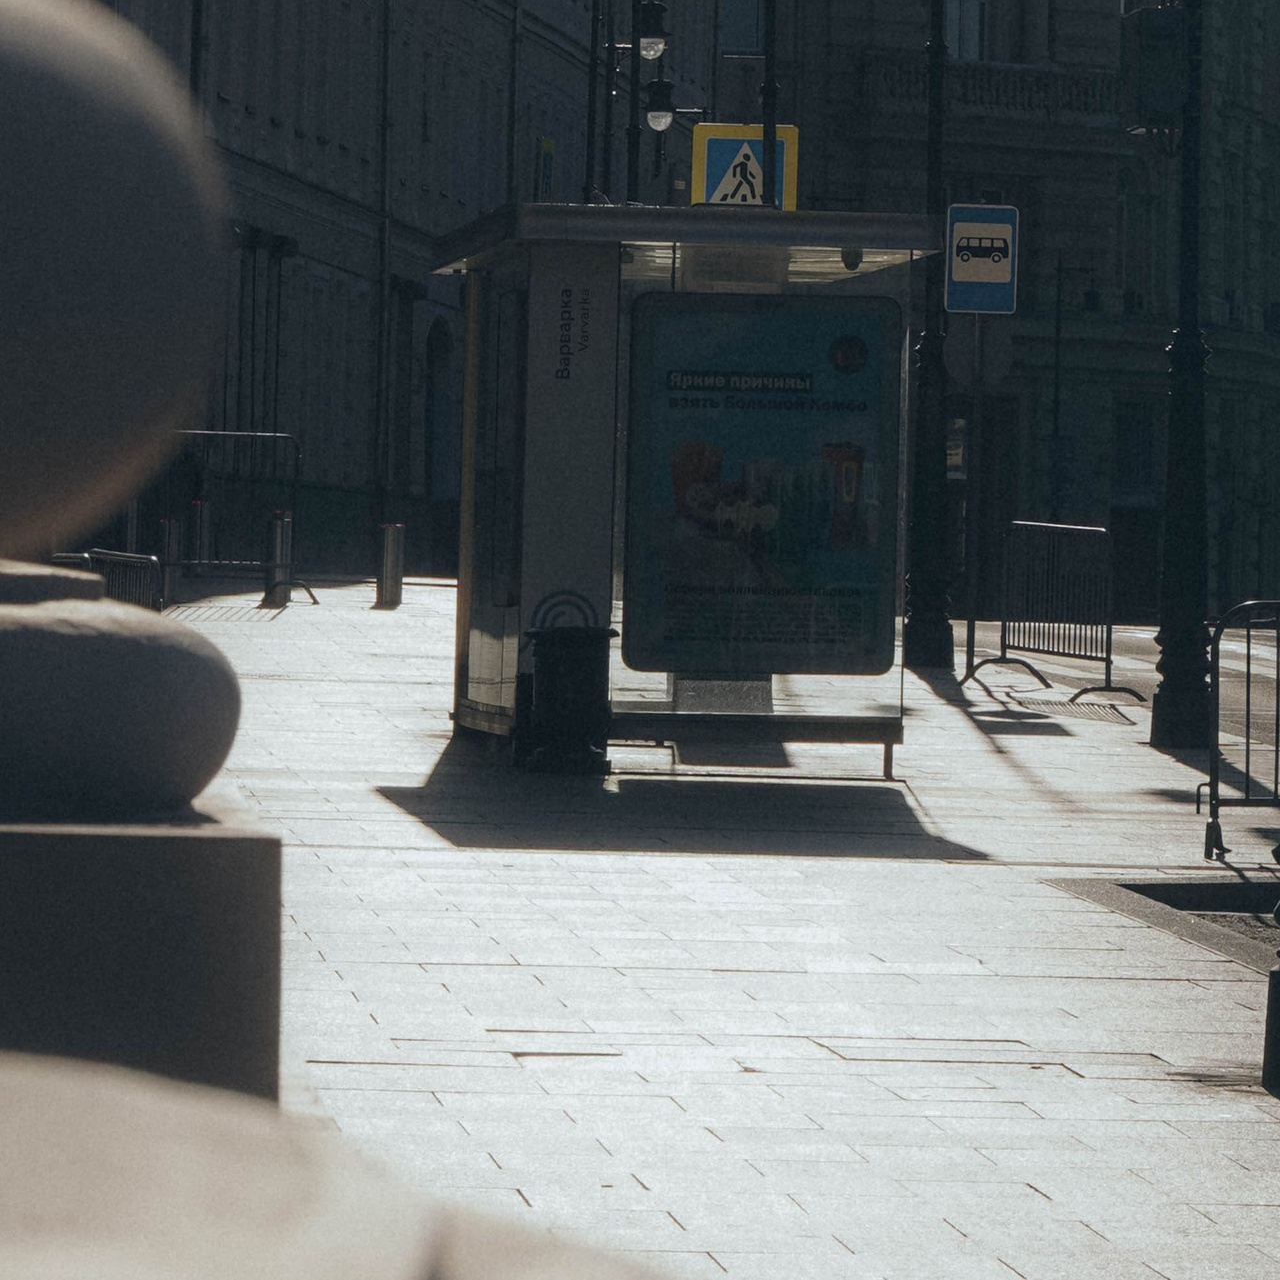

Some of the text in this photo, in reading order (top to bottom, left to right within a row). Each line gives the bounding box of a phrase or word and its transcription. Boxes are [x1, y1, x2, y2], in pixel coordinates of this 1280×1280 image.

[555, 288, 575, 380] Варварка
[578, 288, 590, 352] Varvarka
[670, 372, 810, 390] Яркие причины
